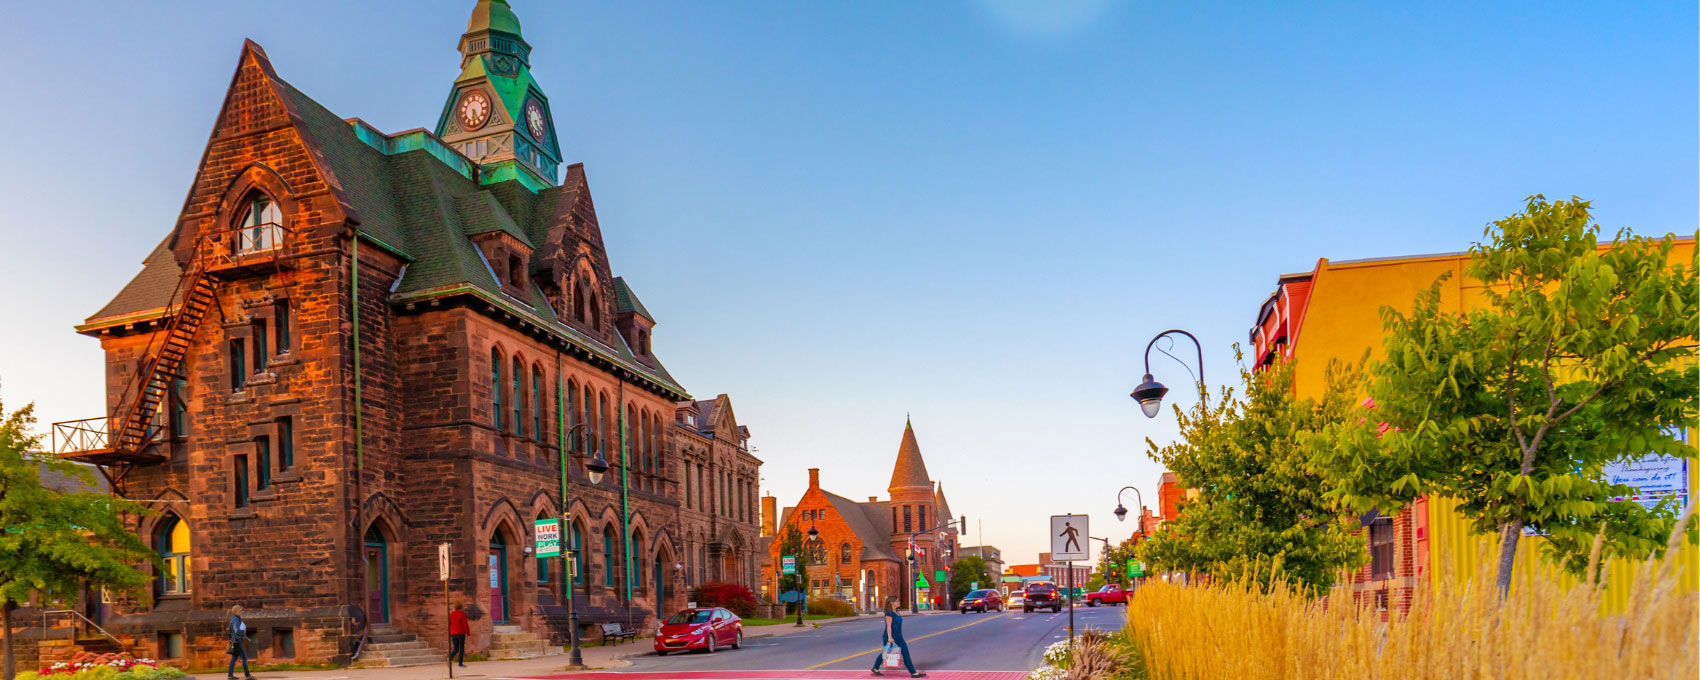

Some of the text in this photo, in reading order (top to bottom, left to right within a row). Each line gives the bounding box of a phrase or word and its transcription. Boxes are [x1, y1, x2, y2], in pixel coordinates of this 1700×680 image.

[1613, 475, 1629, 484] You
[1651, 473, 1661, 481] do
[537, 524, 557, 533] LIVE
[538, 540, 558, 548] PLAY
